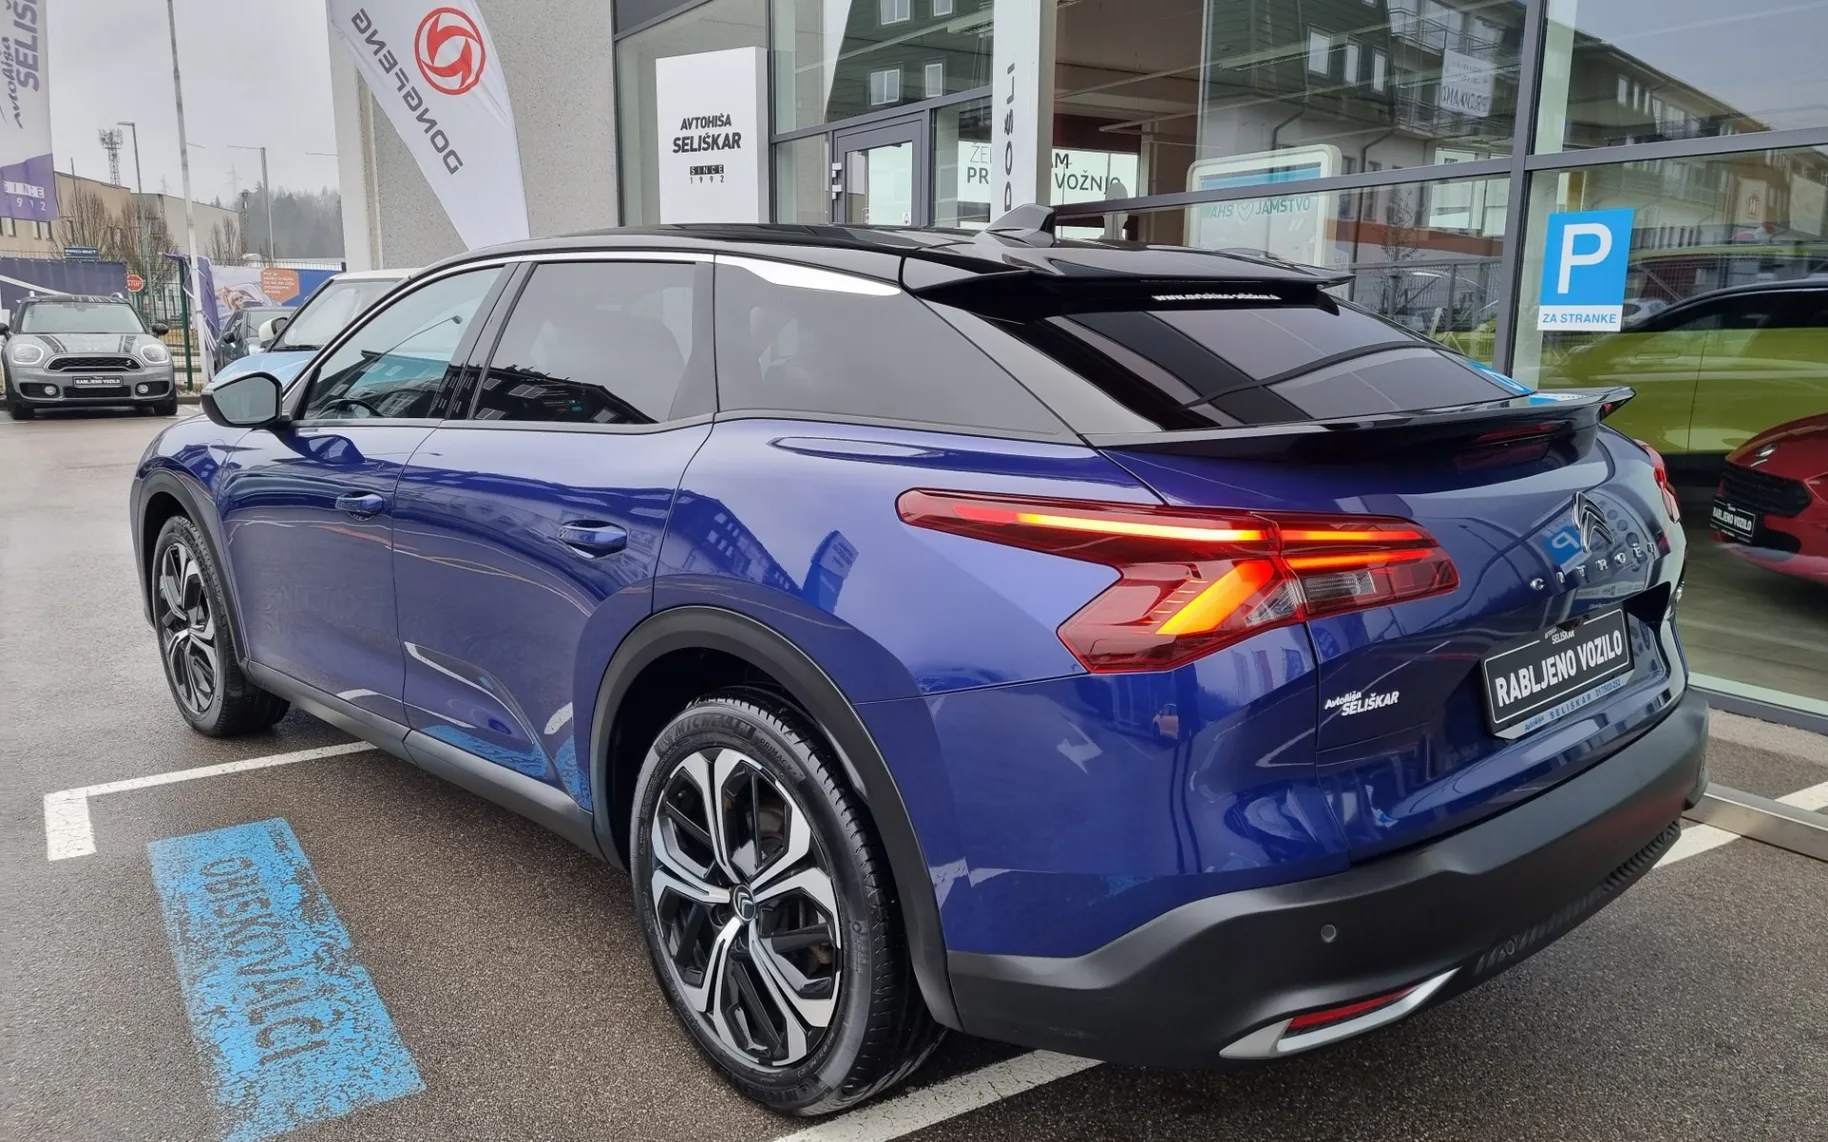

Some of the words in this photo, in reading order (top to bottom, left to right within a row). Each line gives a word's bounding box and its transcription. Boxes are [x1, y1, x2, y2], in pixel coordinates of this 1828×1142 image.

[6, 0, 39, 92] SELIŠ
[680, 113, 732, 131] AVTOHIŠA
[672, 132, 742, 154] SELIŠKAR
[969, 142, 991, 164] ŽE
[690, 165, 724, 175] SINCE
[690, 175, 725, 184] 1992
[967, 166, 989, 184] PR
[1209, 204, 1234, 219] AHS
[1255, 197, 1311, 216] JAMSTVO
[1557, 223, 1613, 294] P
[1542, 313, 1557, 324] ZA
[1560, 313, 1617, 324] STRANKE
[1495, 649, 1577, 707] RABLJENO
[1577, 630, 1623, 671] VOZILO
[1341, 691, 1400, 716] SELIŠKAR
[759, 737, 793, 772] PRIMACY
